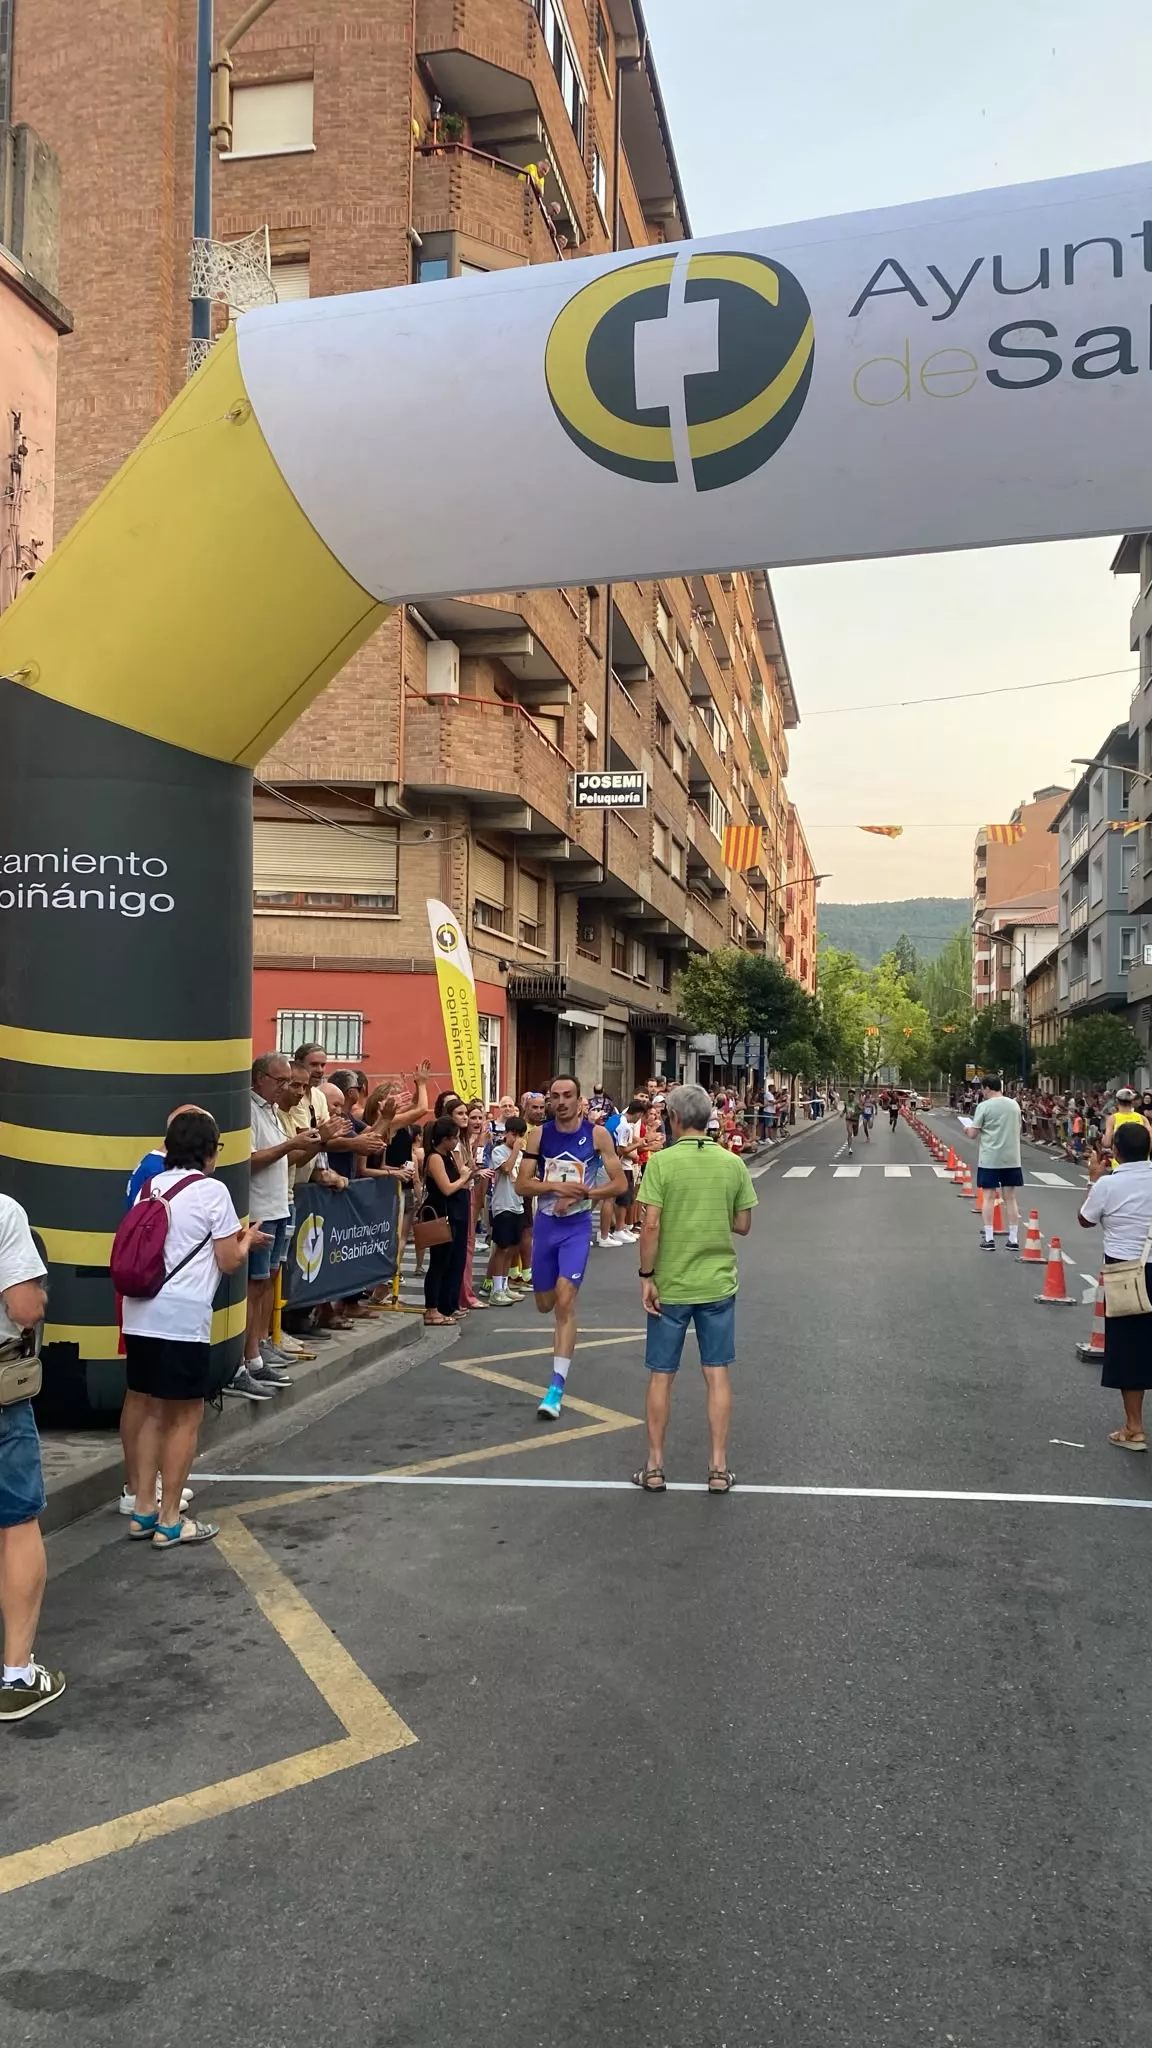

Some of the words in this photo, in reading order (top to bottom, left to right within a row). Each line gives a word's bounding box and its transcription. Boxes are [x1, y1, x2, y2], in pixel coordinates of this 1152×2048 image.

[579, 775, 642, 789] JOSEMI
[579, 792, 640, 805] Peluquería
[0, 848, 168, 877] amiento
[330, 1220, 390, 1245] Ayuntamiento
